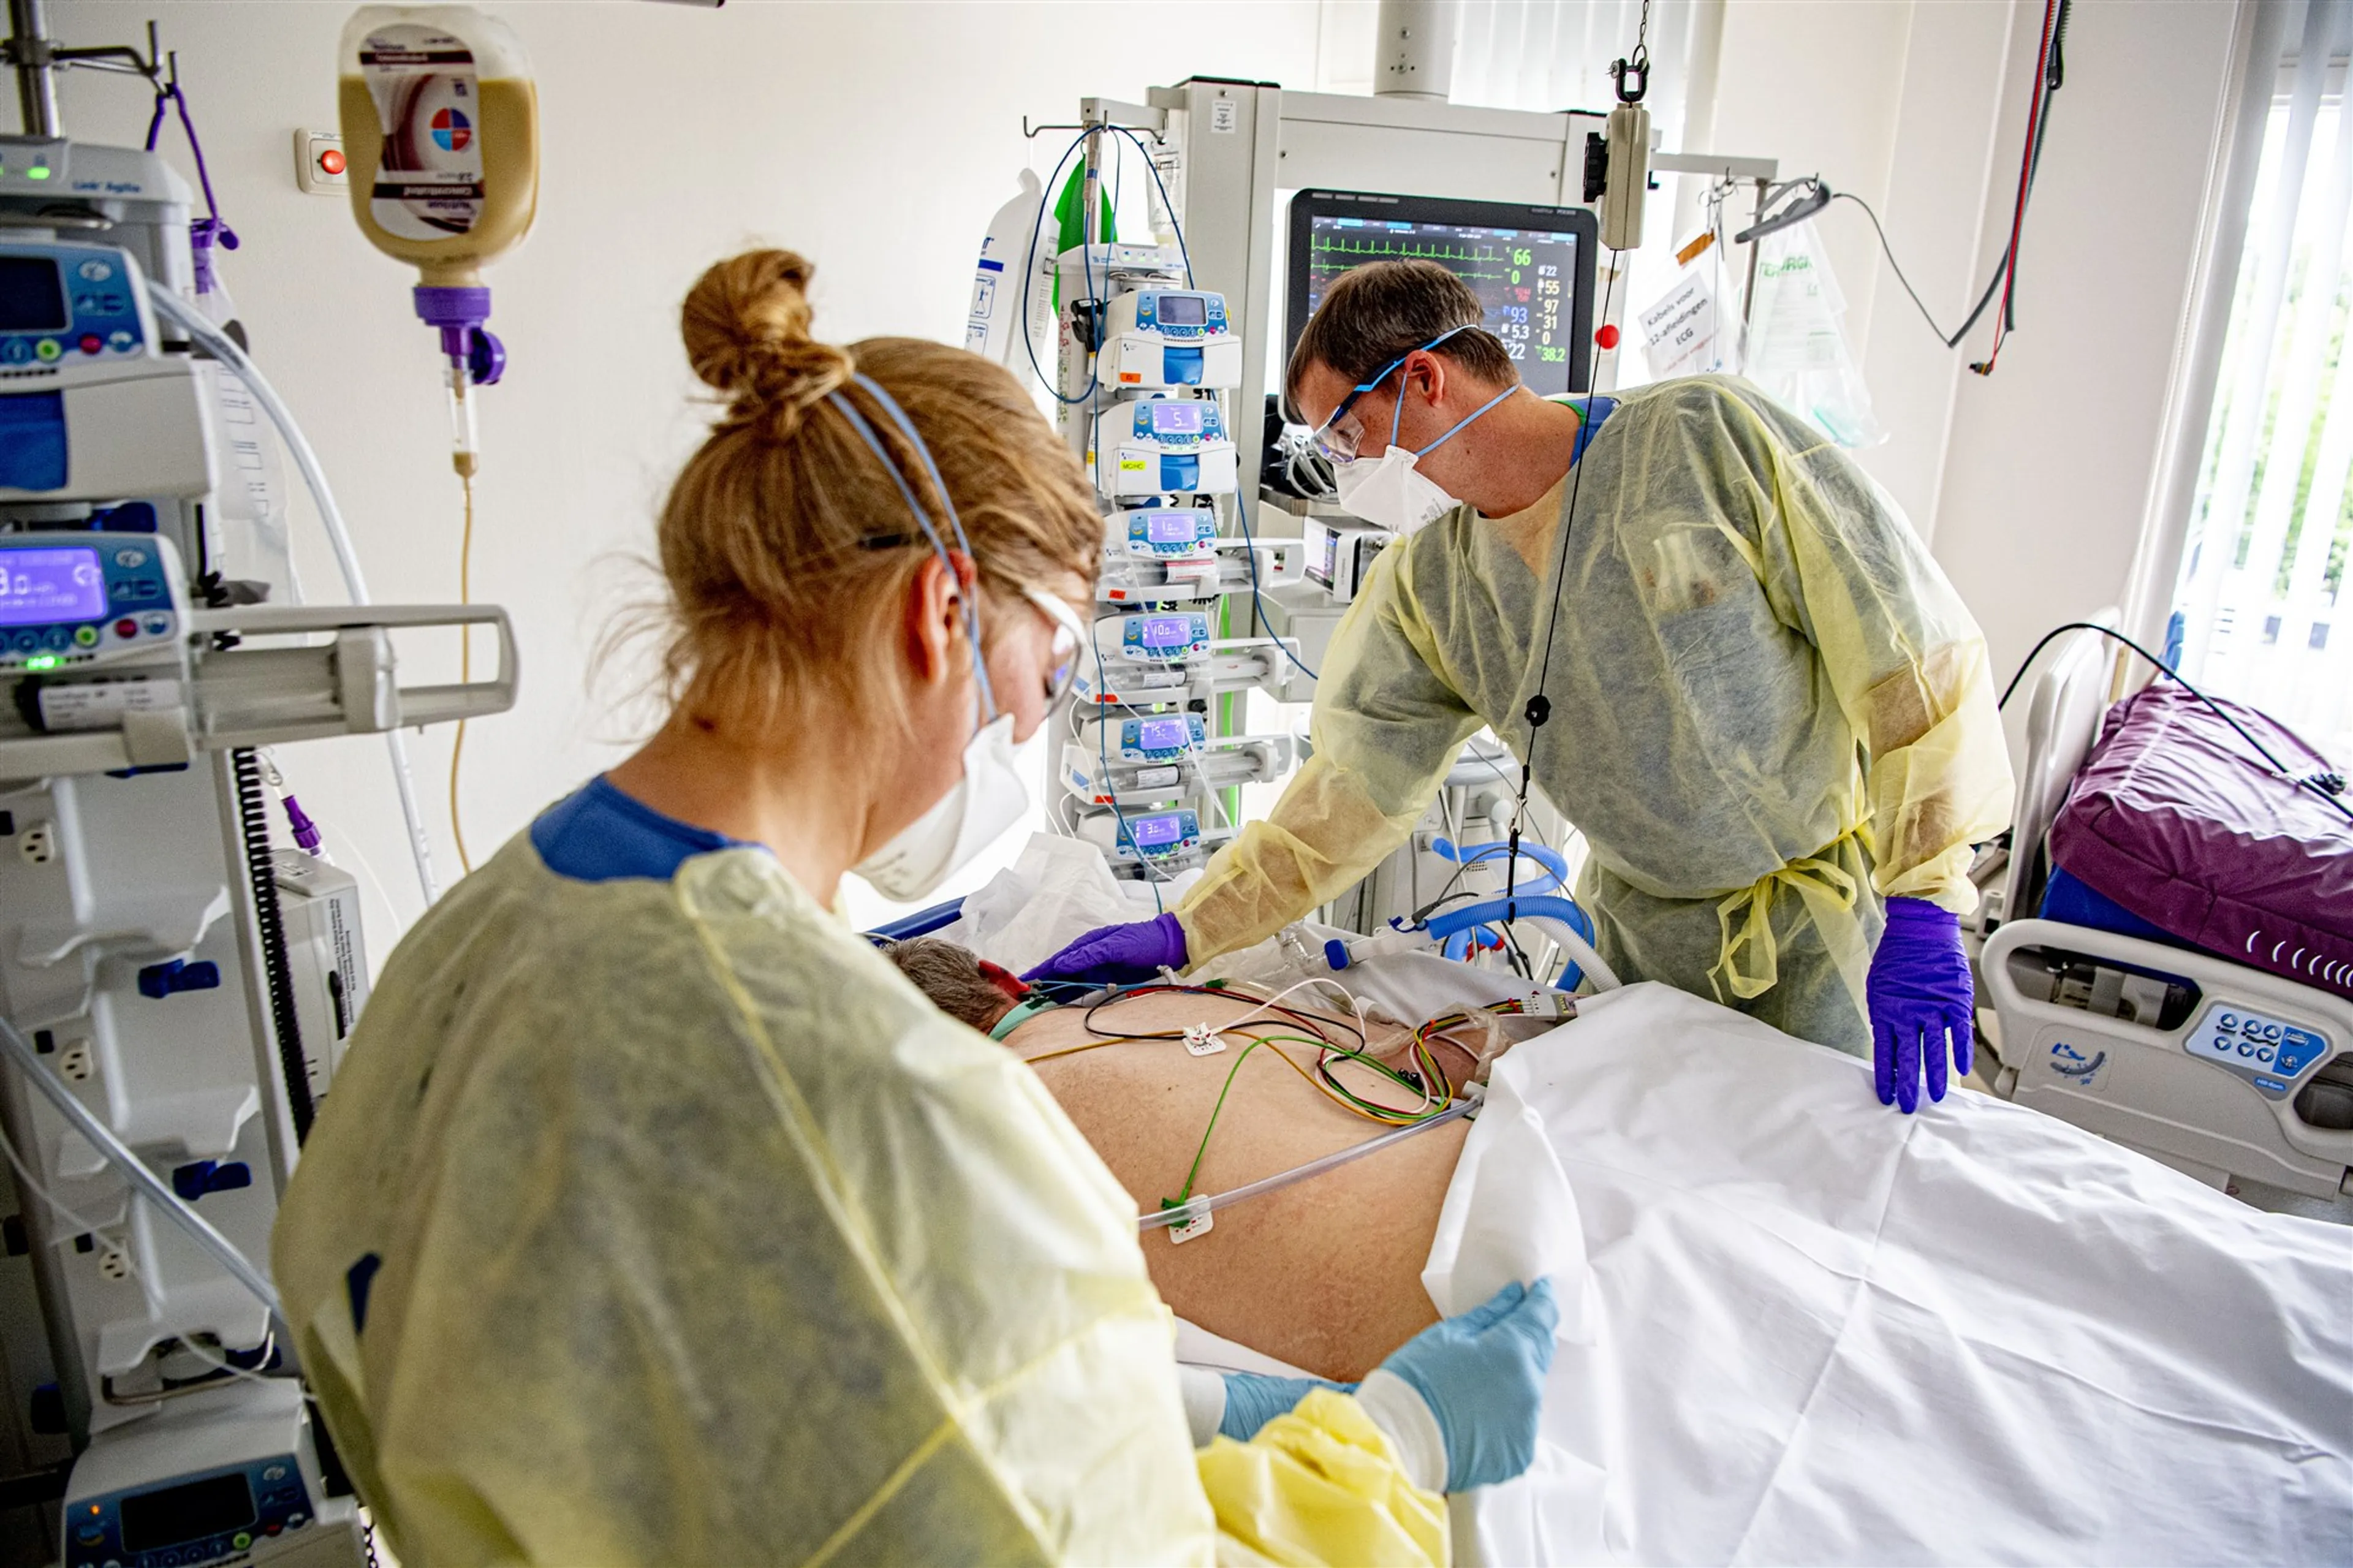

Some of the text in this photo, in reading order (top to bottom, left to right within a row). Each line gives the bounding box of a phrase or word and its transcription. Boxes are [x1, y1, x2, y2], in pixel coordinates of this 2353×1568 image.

[1514, 248, 1531, 266] 66
[1511, 270, 1520, 284] 0
[1545, 265, 1558, 276] 22
[1545, 280, 1560, 295] 55
[1544, 299, 1559, 314] 97
[1648, 287, 1694, 326] Kabels voor
[1510, 306, 1528, 323] 93
[1543, 315, 1558, 330] 31
[1512, 325, 1530, 340] 5.3
[1542, 331, 1551, 345] 0
[1675, 327, 1694, 346] ECG
[1541, 346, 1566, 362] 38.2
[1173, 412, 1183, 427] 5
